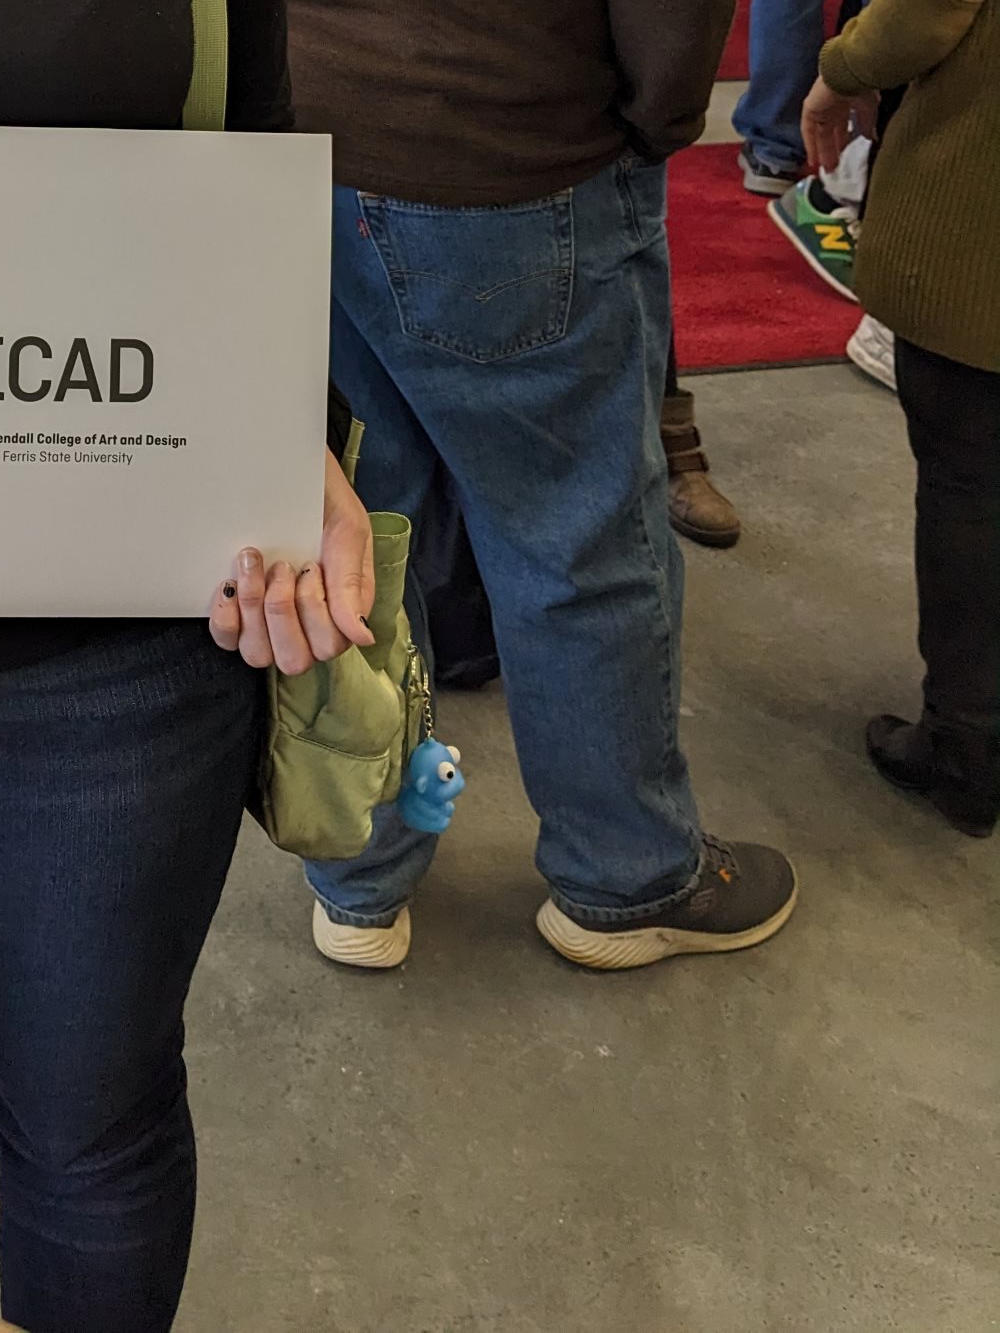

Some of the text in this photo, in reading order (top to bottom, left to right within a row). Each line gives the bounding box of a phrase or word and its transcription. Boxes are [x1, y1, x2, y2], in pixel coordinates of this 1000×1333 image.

[37, 432, 81, 448] College
[84, 433, 97, 445] of
[99, 433, 118, 446] Art
[120, 434, 143, 446] and
[145, 434, 187, 448] Design
[3, 450, 37, 463] Ferris
[39, 450, 71, 463] State
[74, 451, 134, 466] University
